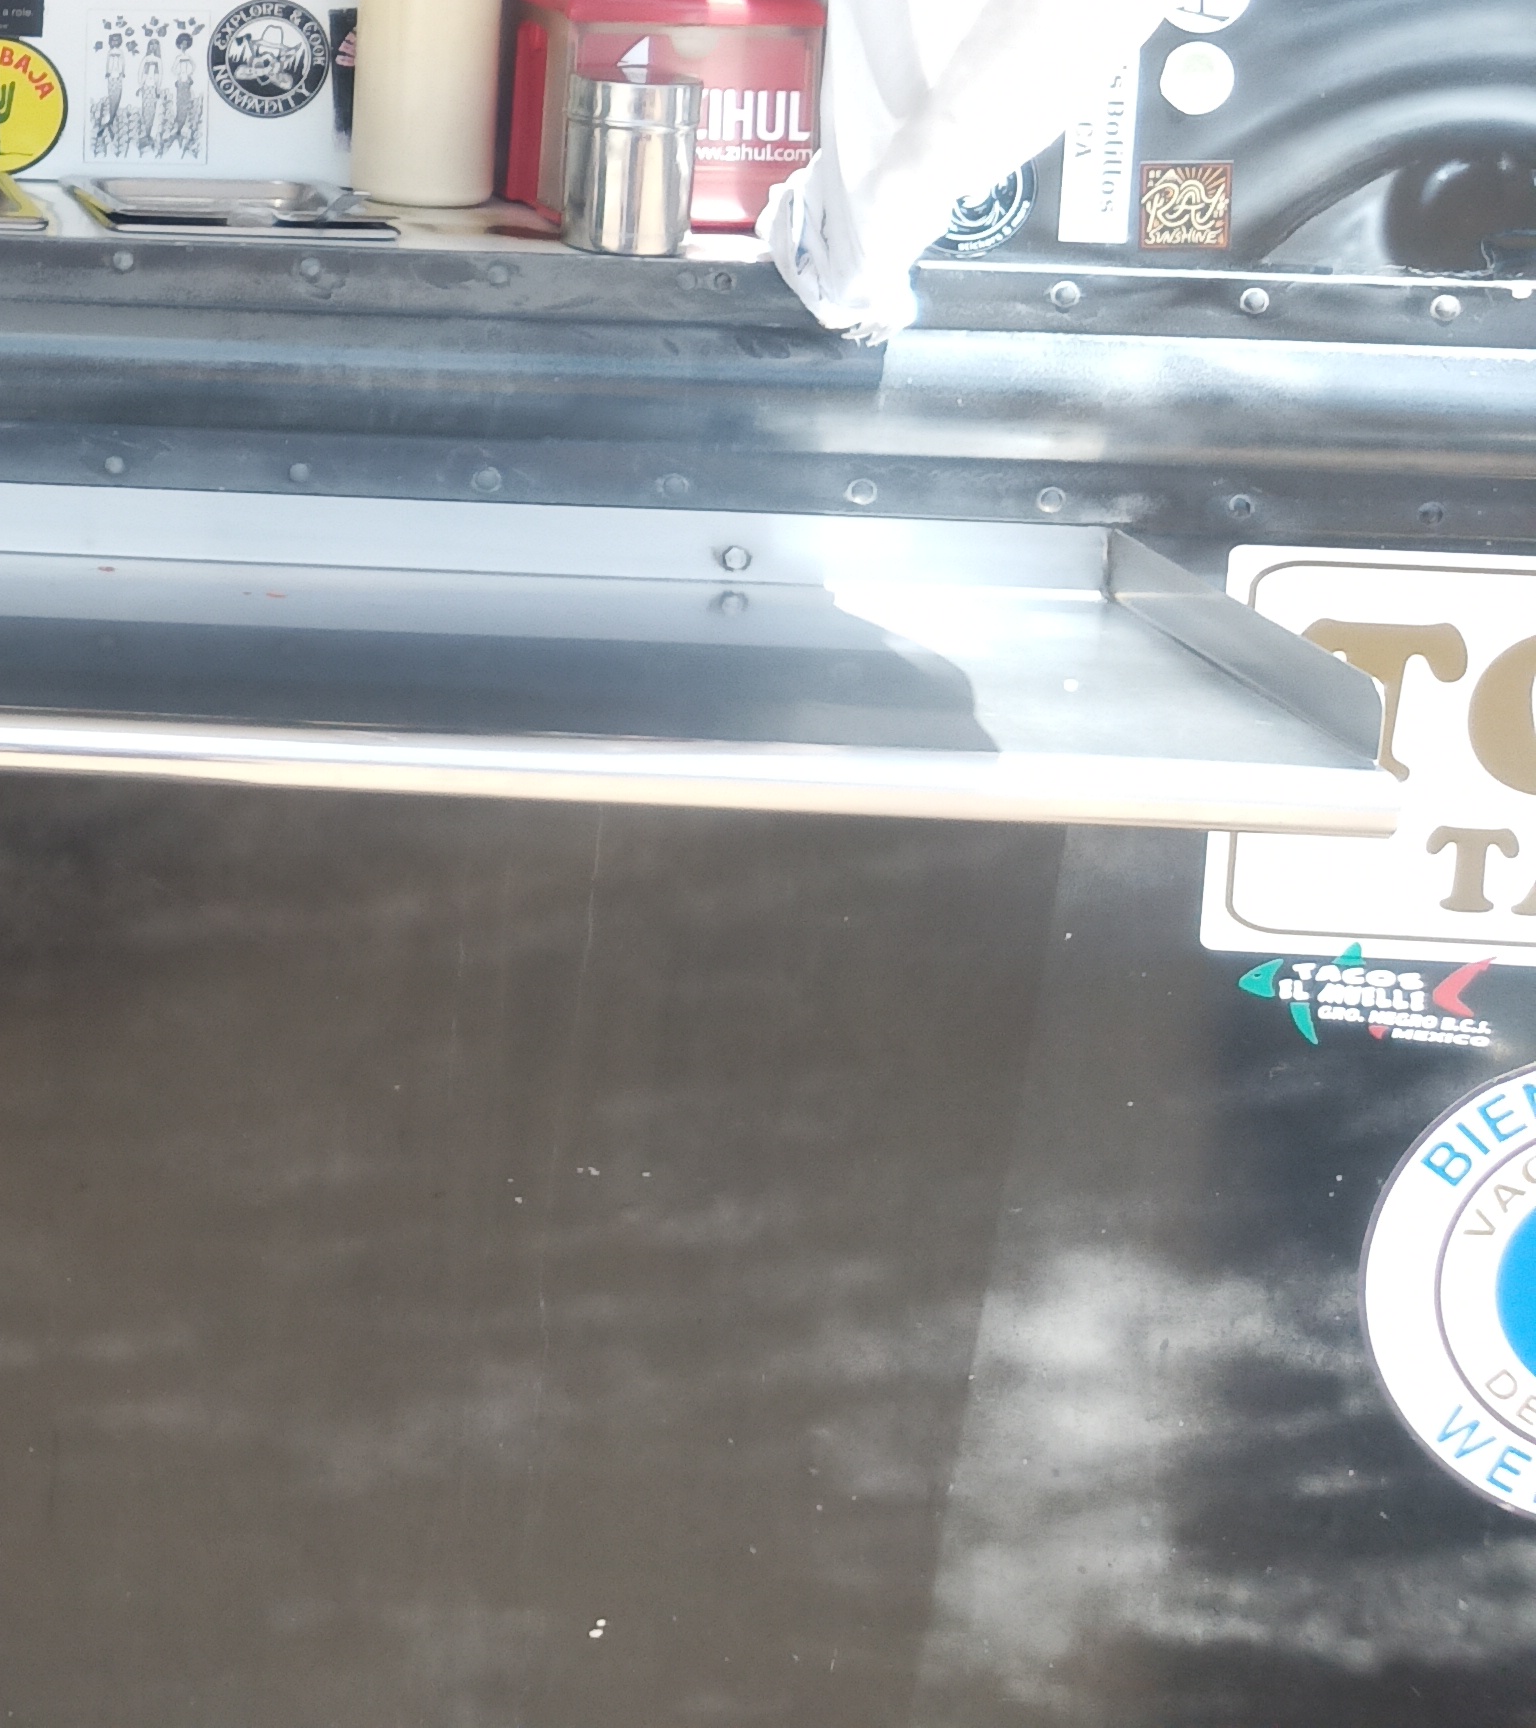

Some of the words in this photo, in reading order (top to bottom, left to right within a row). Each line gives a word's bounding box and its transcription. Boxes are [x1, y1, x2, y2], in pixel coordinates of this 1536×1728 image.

[214, 1, 284, 50] EXPLORE
[1144, 227, 1222, 245] SUNSHINE
[1291, 962, 1425, 991] TACOS
[1278, 978, 1311, 1001] EL
[1316, 982, 1426, 1012] MUELLE
[1316, 1005, 1365, 1023] GRO.
[1368, 1010, 1438, 1030] NEGRO
[1390, 1026, 1492, 1048] MEXICO
